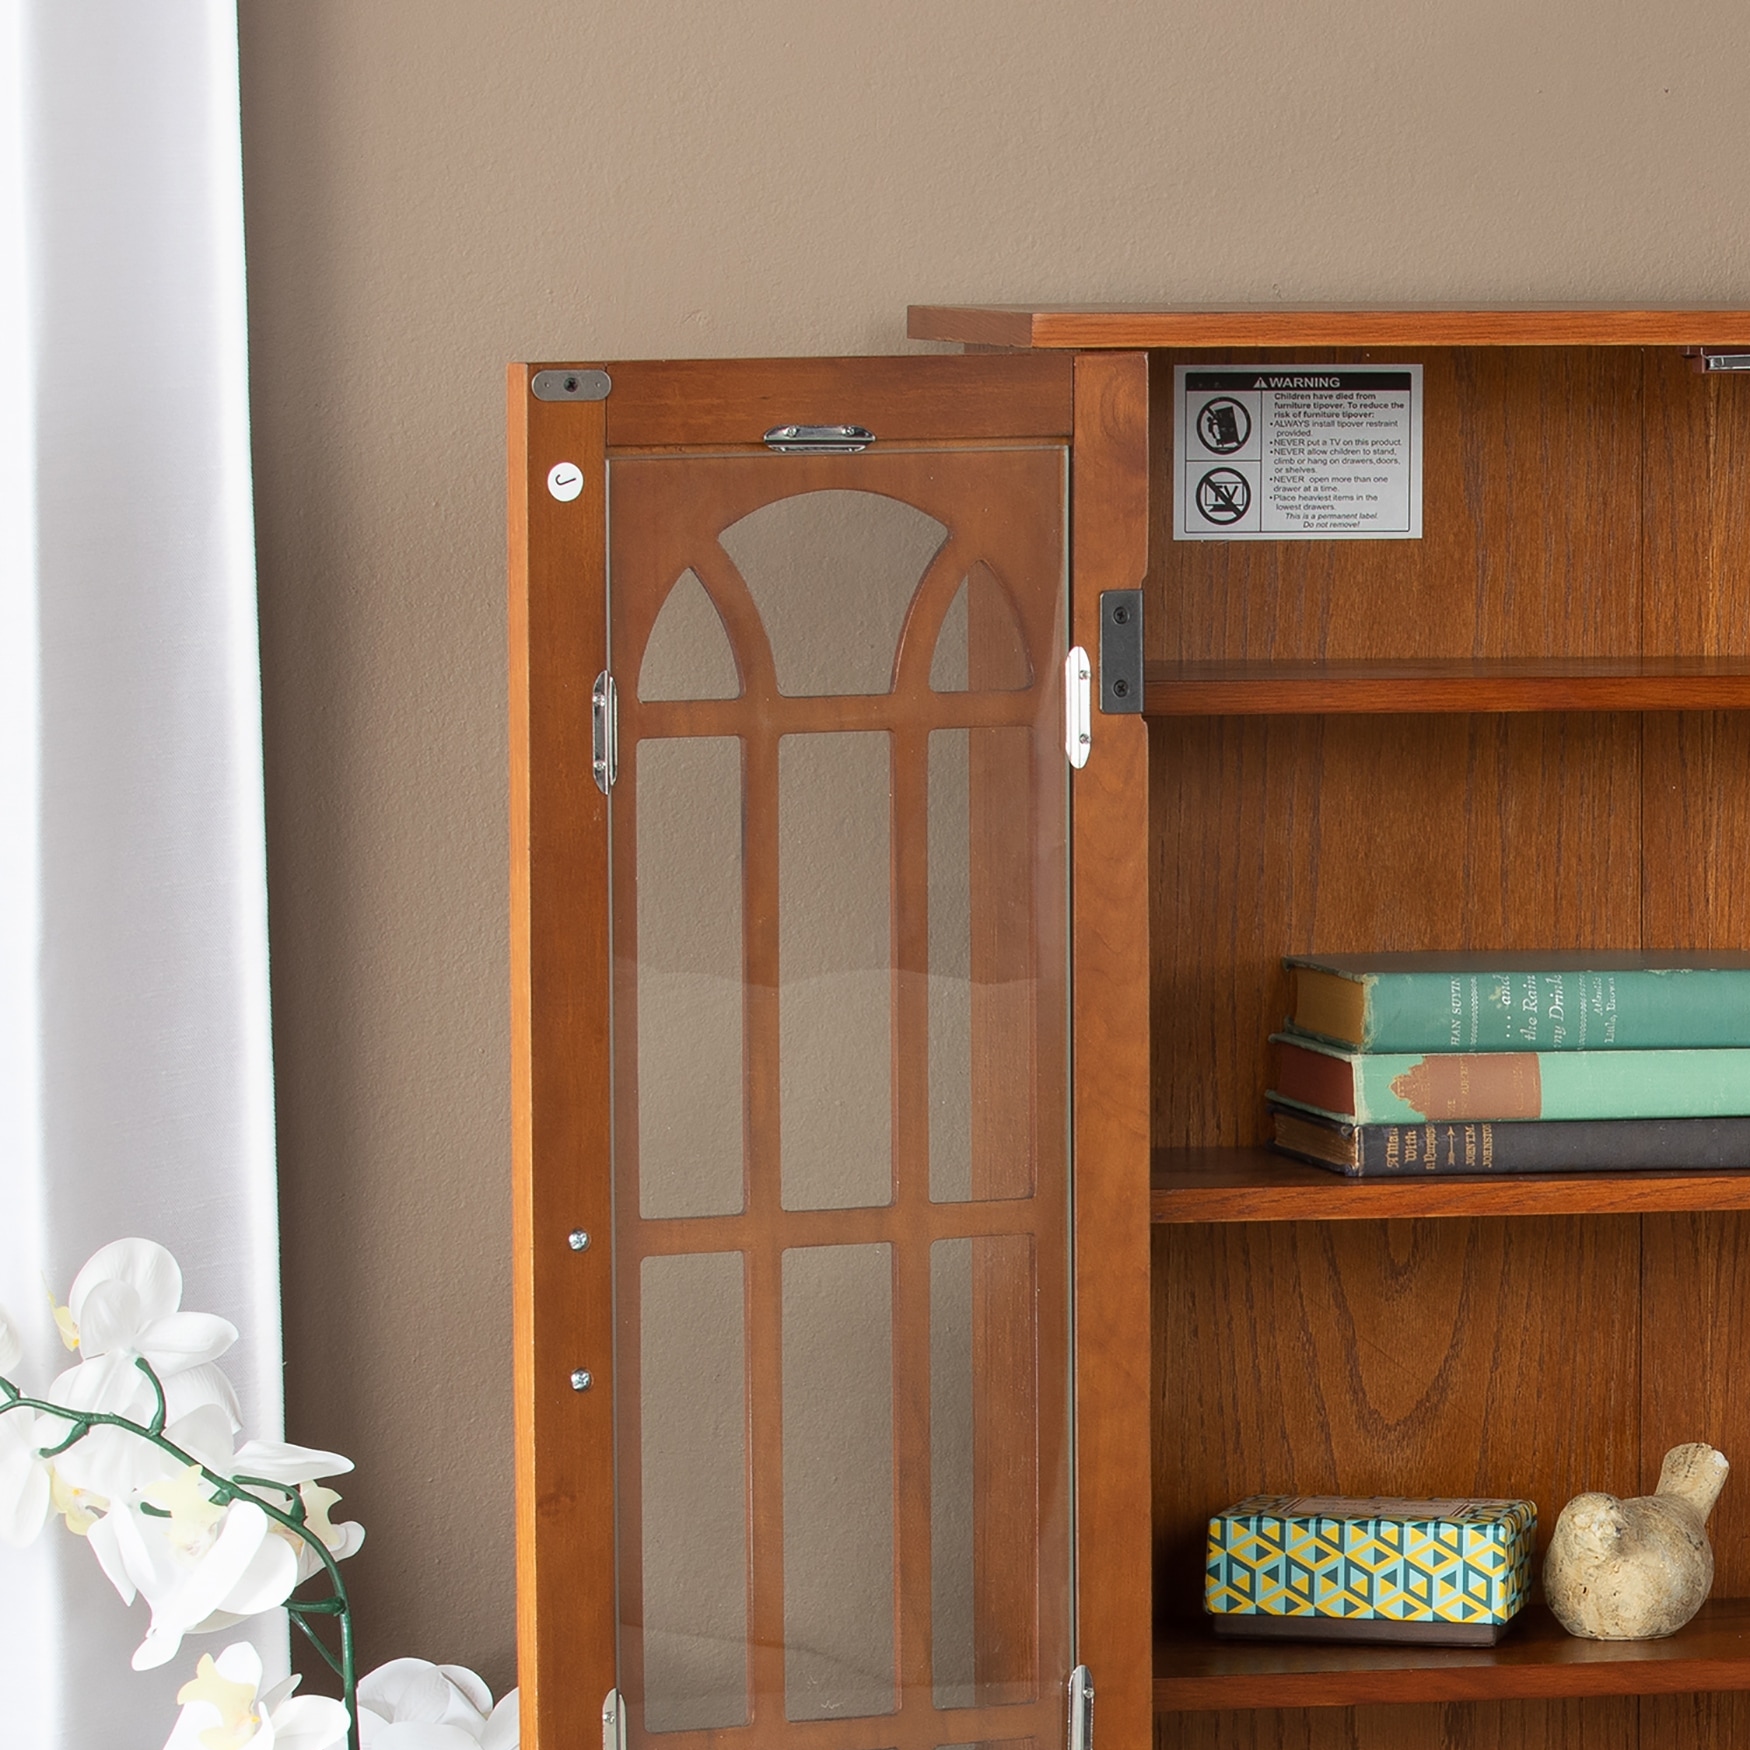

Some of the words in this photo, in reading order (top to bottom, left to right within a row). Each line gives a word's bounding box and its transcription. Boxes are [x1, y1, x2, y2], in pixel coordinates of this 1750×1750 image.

[1269, 377, 1341, 388] WARNING
[1313, 402, 1344, 410] tipover.
[1341, 411, 1375, 419] tipover:
[1337, 420, 1363, 429] tipover
[1307, 439, 1320, 448] put
[1373, 448, 1397, 457] stand,
[1307, 457, 1328, 466] hang
[1308, 476, 1330, 485] open
[1285, 512, 1301, 520] This
[1302, 512, 1309, 520] is
[1317, 512, 1358, 521] permanent
[1450, 975, 1463, 1015] SUYIN
[1492, 973, 1511, 1006] and
[1522, 974, 1538, 1013] Rain
[1545, 973, 1564, 1022] Drink
[1450, 1019, 1462, 1046] HAN
[1520, 1017, 1538, 1041] the
[1404, 1130, 1417, 1164] With
[1465, 1143, 1476, 1167] JOHN
